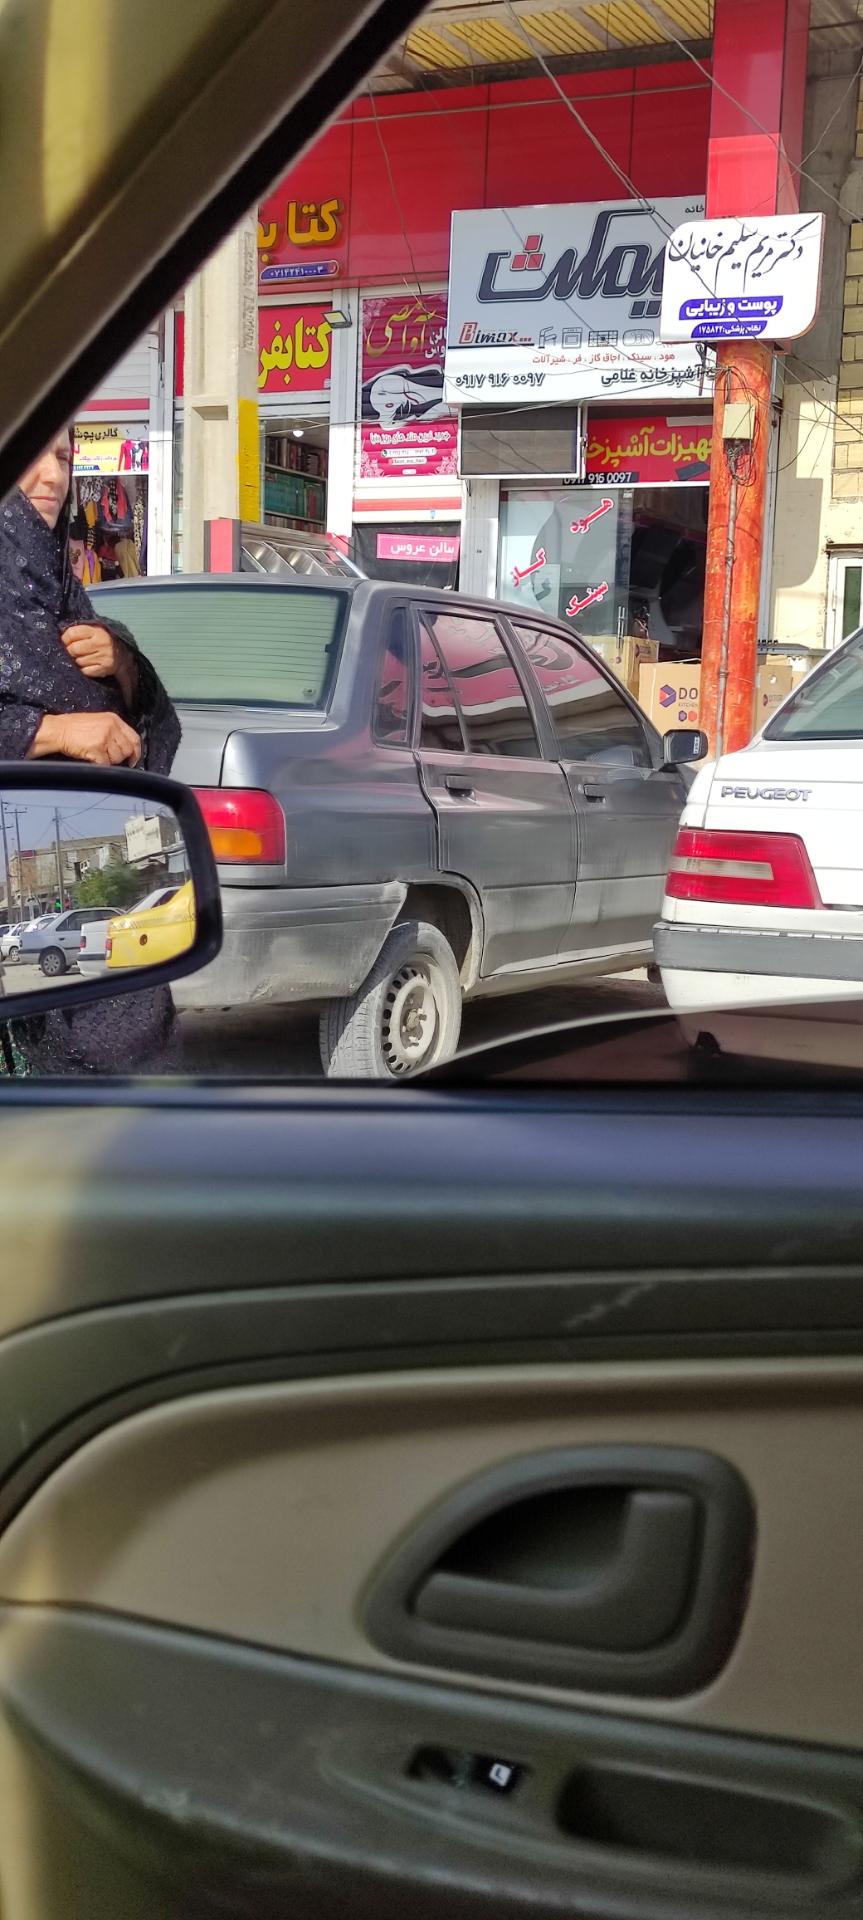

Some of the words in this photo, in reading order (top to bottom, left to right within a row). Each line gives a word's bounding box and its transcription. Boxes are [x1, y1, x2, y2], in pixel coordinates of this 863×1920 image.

[762, 215, 819, 275] دکتر
[743, 235, 773, 294] مریم
[685, 298, 727, 317] زیبایی
[727, 304, 736, 317] و
[737, 299, 778, 315] پوست
[589, 354, 601, 364] گاز
[603, 353, 620, 363] اجاق
[627, 352, 652, 362] سینک
[659, 353, 675, 361] هود
[600, 367, 637, 386] غلامی
[94, 427, 118, 441] گالری
[650, 432, 713, 462] هیزات
[588, 473, 605, 485] 916
[606, 472, 633, 484] 0097
[390, 543, 426, 556] عروس
[429, 541, 455, 557] سالن
[720, 785, 813, 802] PEUGEOT
